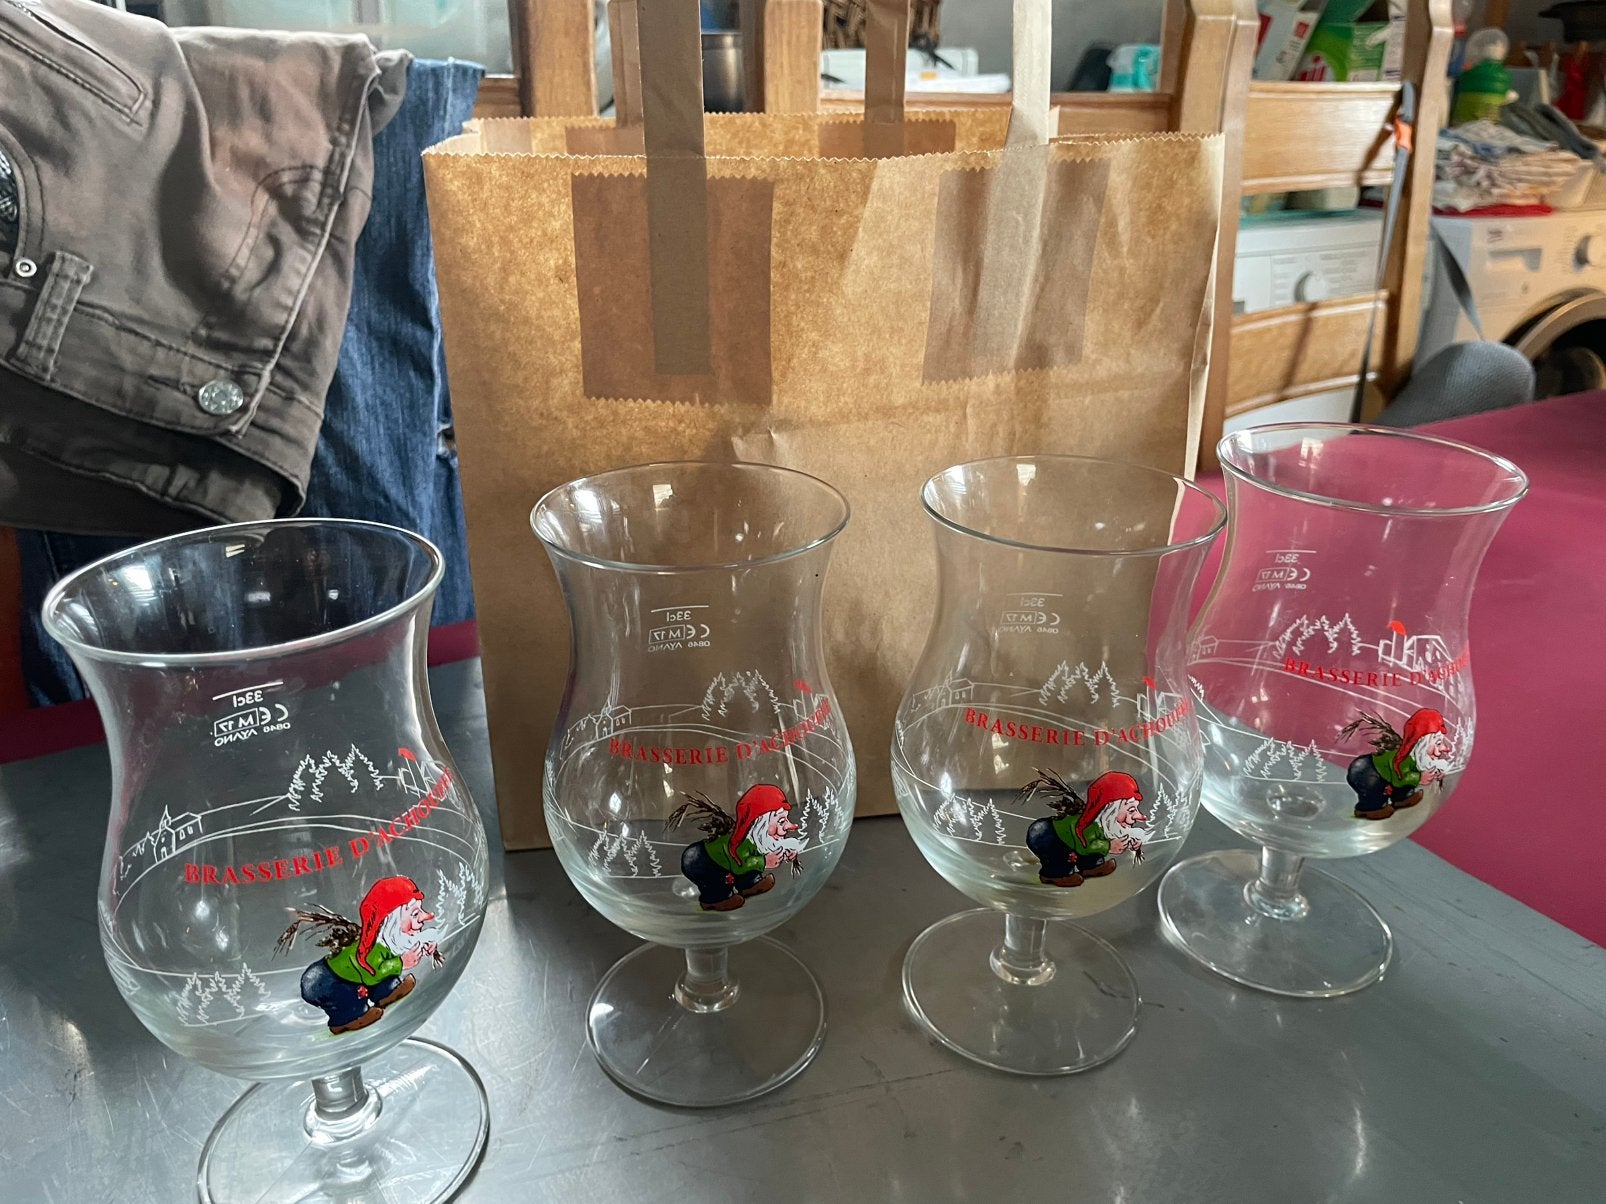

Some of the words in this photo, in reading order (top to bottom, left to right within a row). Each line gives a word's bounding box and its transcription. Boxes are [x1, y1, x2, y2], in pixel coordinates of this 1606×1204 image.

[1283, 656, 1402, 687] BRASSERIE
[965, 707, 1086, 746] BRASSERIE
[609, 737, 729, 765] BRASSERIE
[184, 847, 344, 887] BRASSERIE
